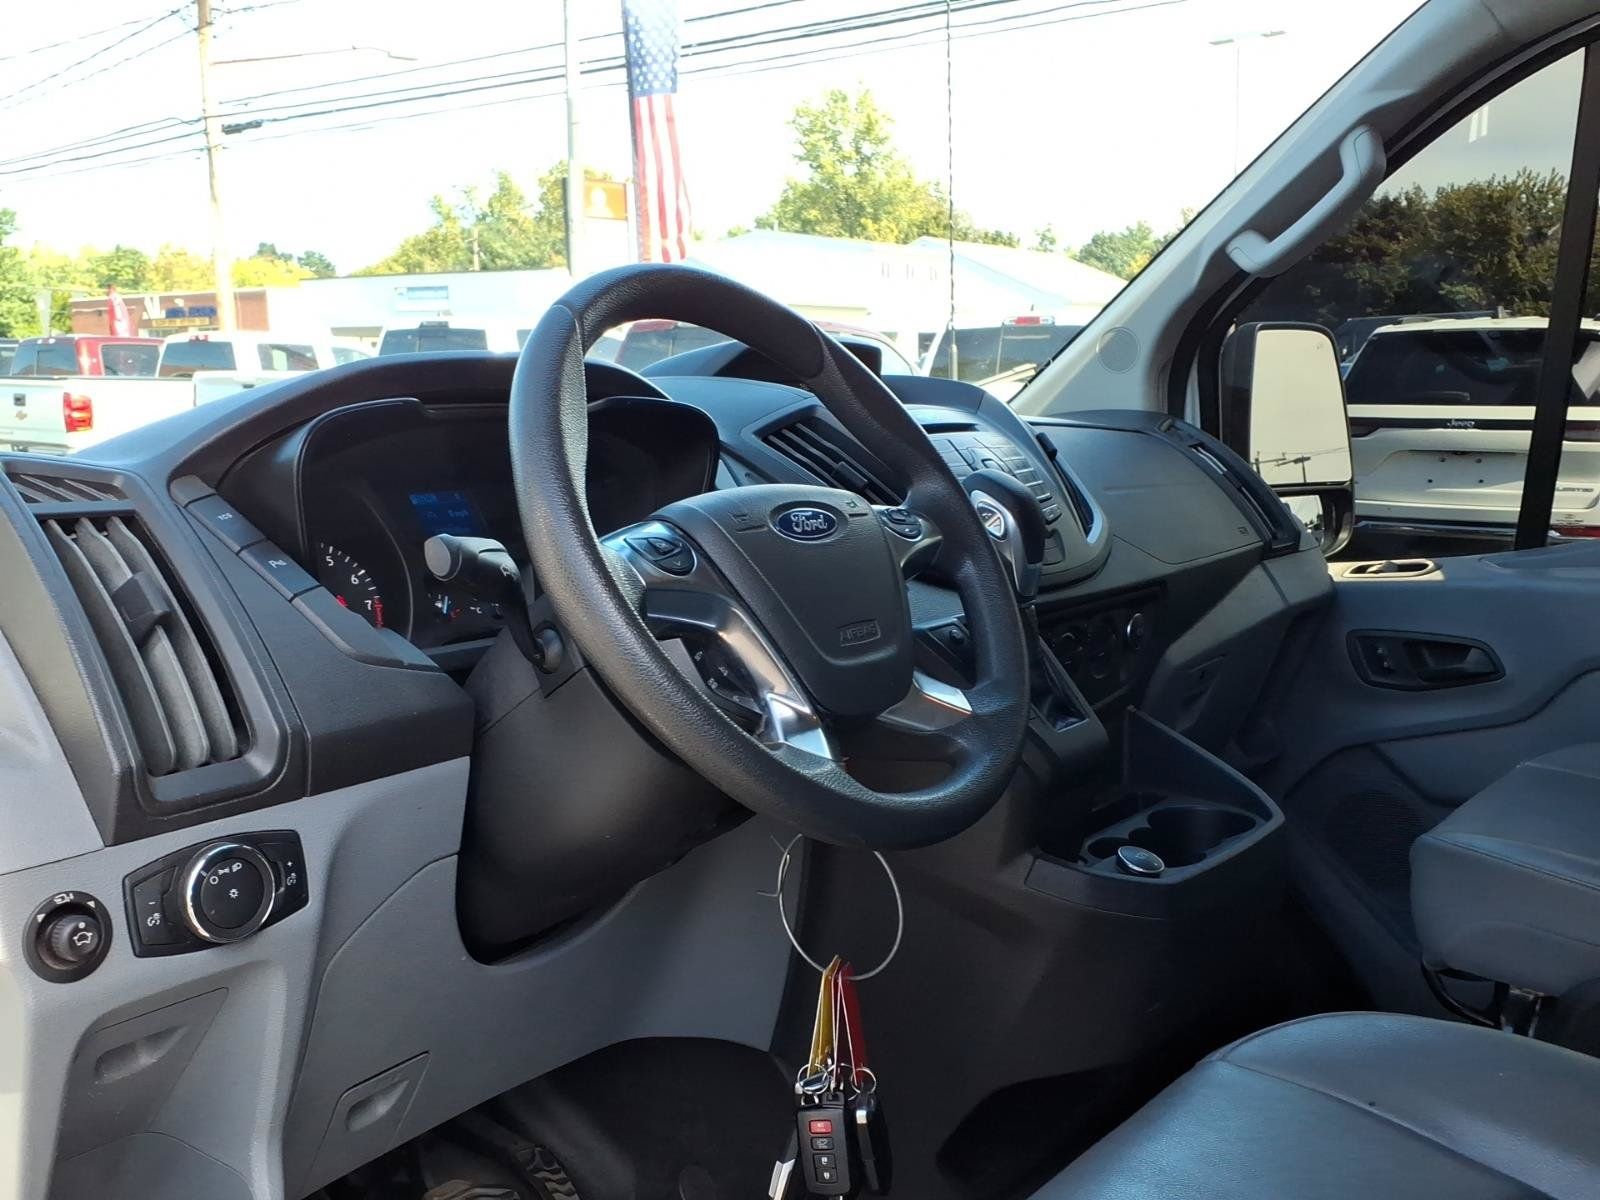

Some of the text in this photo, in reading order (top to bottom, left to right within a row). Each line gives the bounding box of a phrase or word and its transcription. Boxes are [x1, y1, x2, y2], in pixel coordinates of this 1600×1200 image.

[1446, 418, 1475, 428] Jeep
[790, 511, 828, 532] Ford
[325, 555, 334, 567] 5
[351, 574, 359, 585] 6
[364, 599, 372, 611] 7
